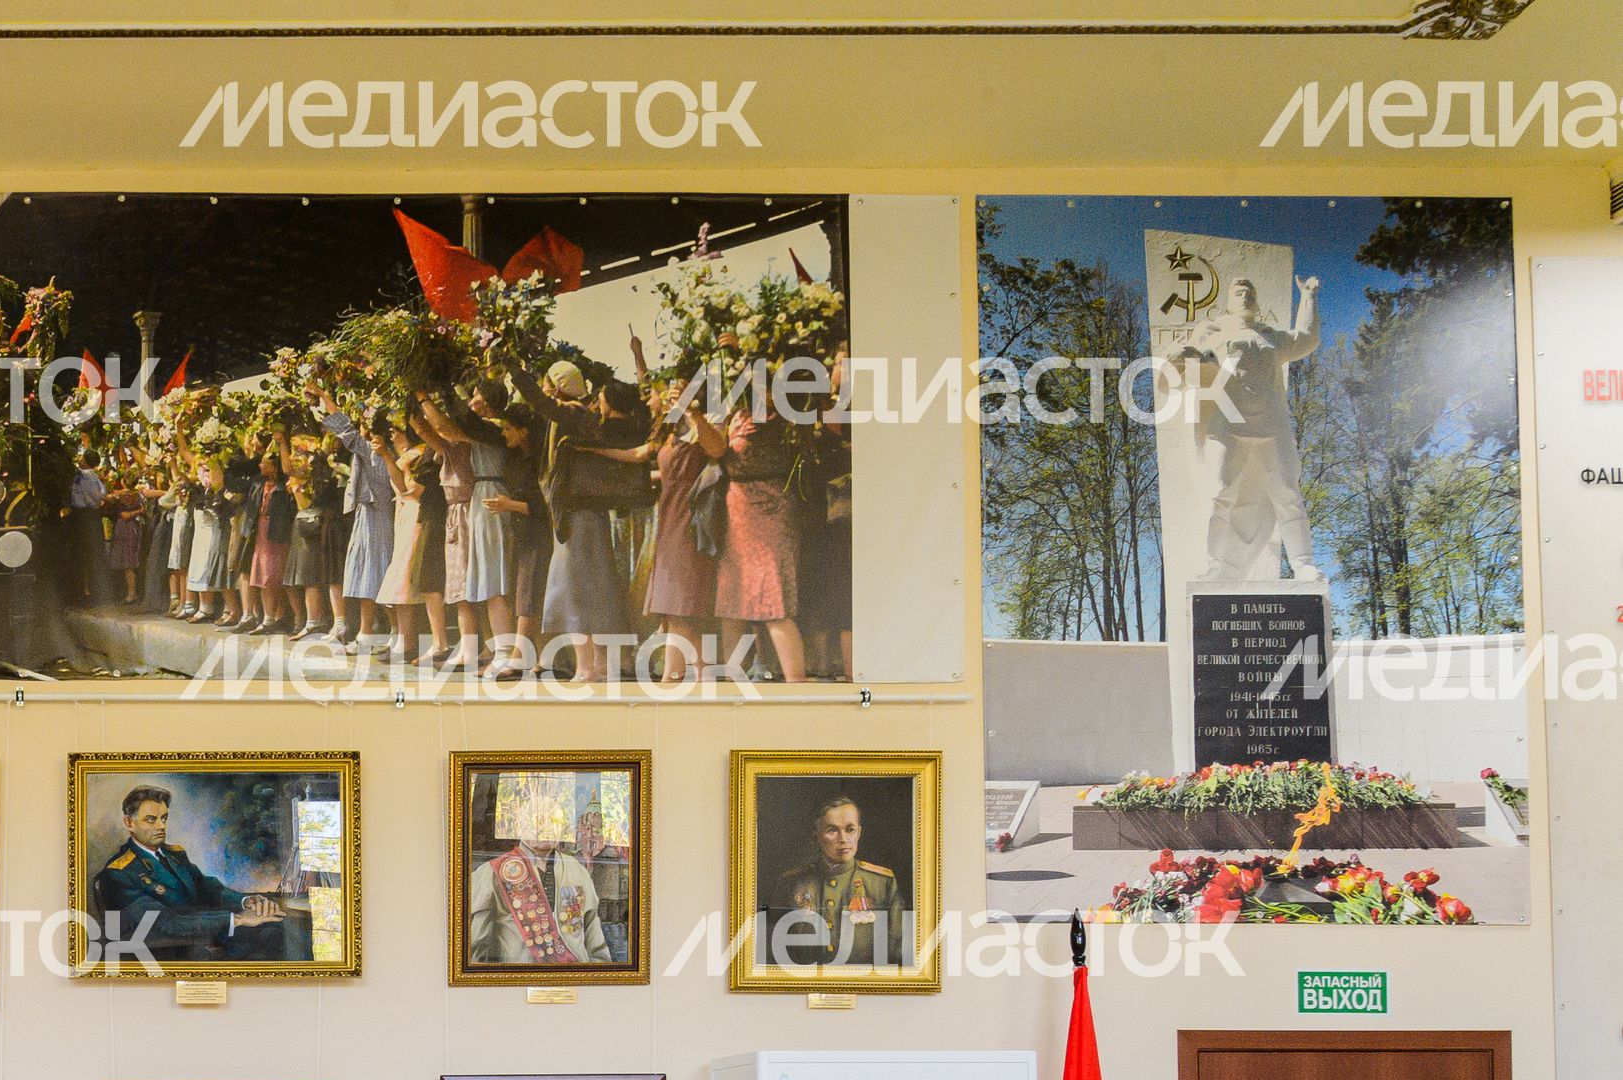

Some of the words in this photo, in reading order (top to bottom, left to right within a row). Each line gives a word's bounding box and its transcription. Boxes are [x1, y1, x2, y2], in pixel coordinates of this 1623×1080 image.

[1583, 369, 1623, 401] ВЕЛ
[1231, 603, 1237, 614] В
[1244, 603, 1286, 614] ПАМЯТЬ
[1212, 620, 1263, 631] ПОГИБШИХ
[1268, 620, 1306, 631] ВОИНОВ
[1232, 637, 1238, 648] В
[1244, 637, 1287, 649] ПЕРИОД
[1226, 708, 1238, 719] ОТ
[1198, 726, 1242, 737] ГОРОДА
[1248, 725, 1327, 737] ЭЛЕКТРОУГЛИ
[1303, 974, 1382, 988] ЗАПАСНЫЙ
[1303, 989, 1383, 1011] ВЫХОД
